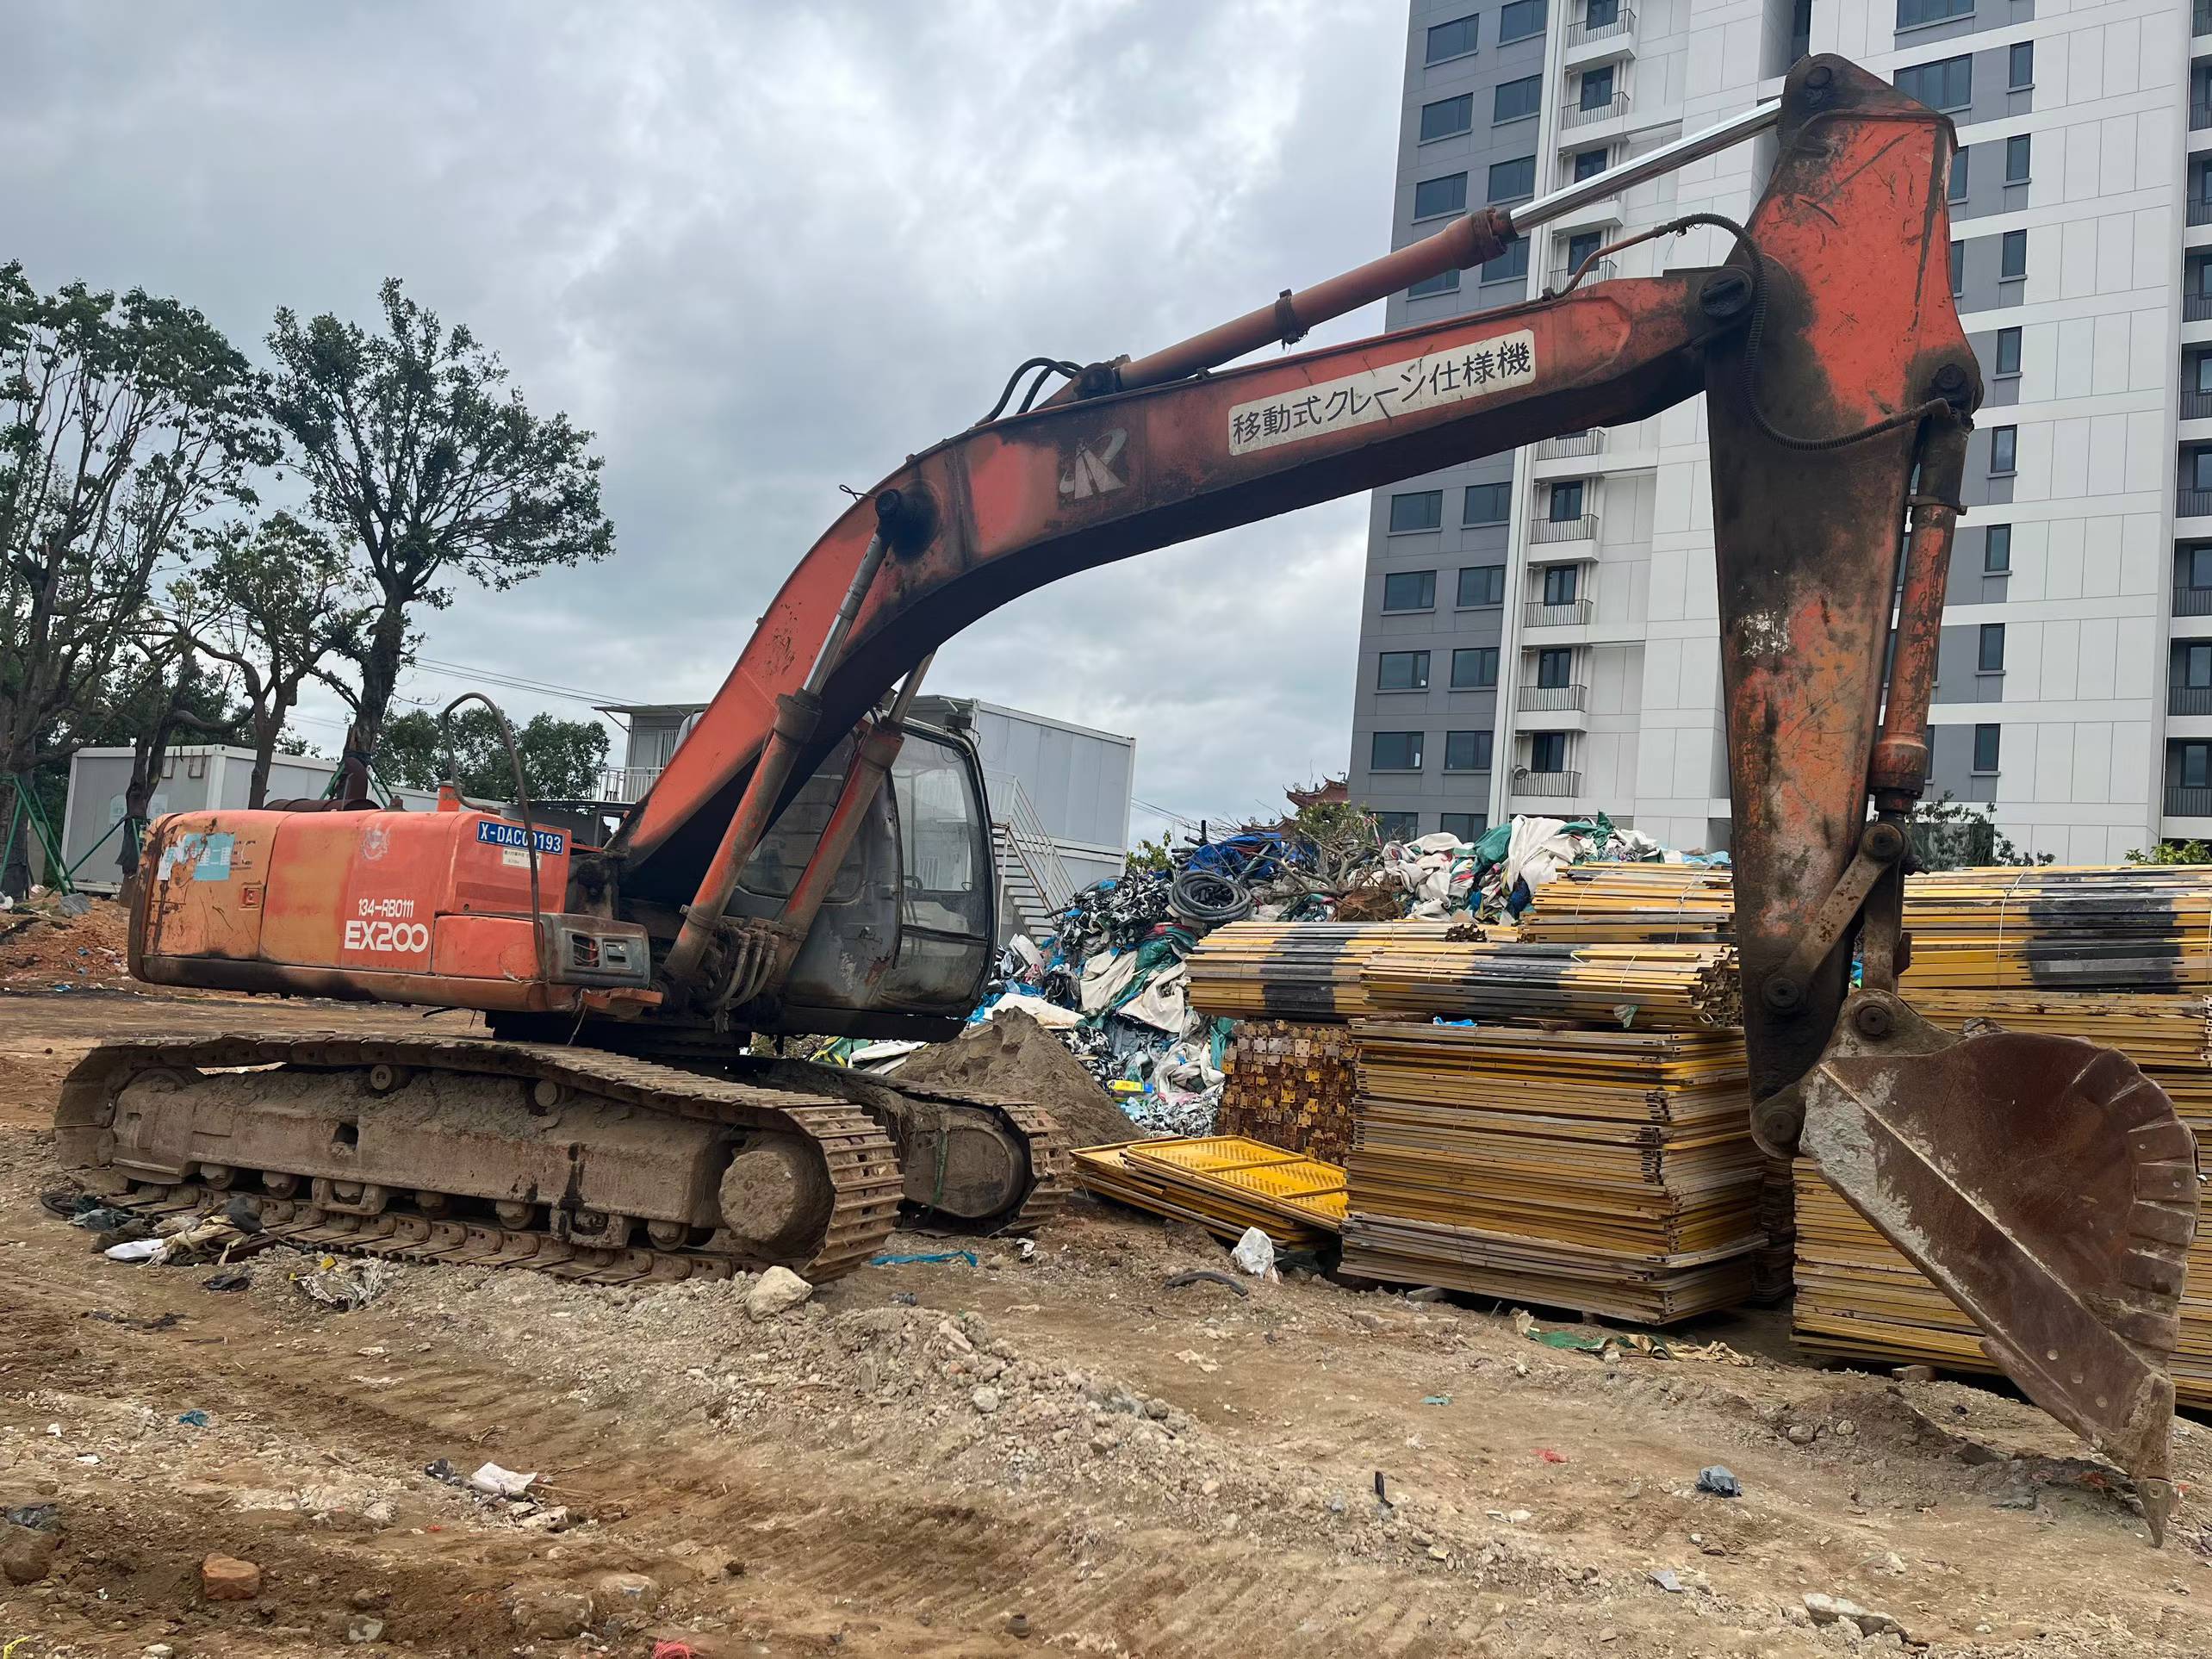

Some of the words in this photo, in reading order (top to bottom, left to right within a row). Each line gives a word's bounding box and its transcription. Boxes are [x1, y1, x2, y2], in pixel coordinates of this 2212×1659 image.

[1233, 341, 1531, 444] 移動式クレーン仕様機
[358, 898, 413, 918] 134-RB0111
[345, 920, 428, 953] EX200
